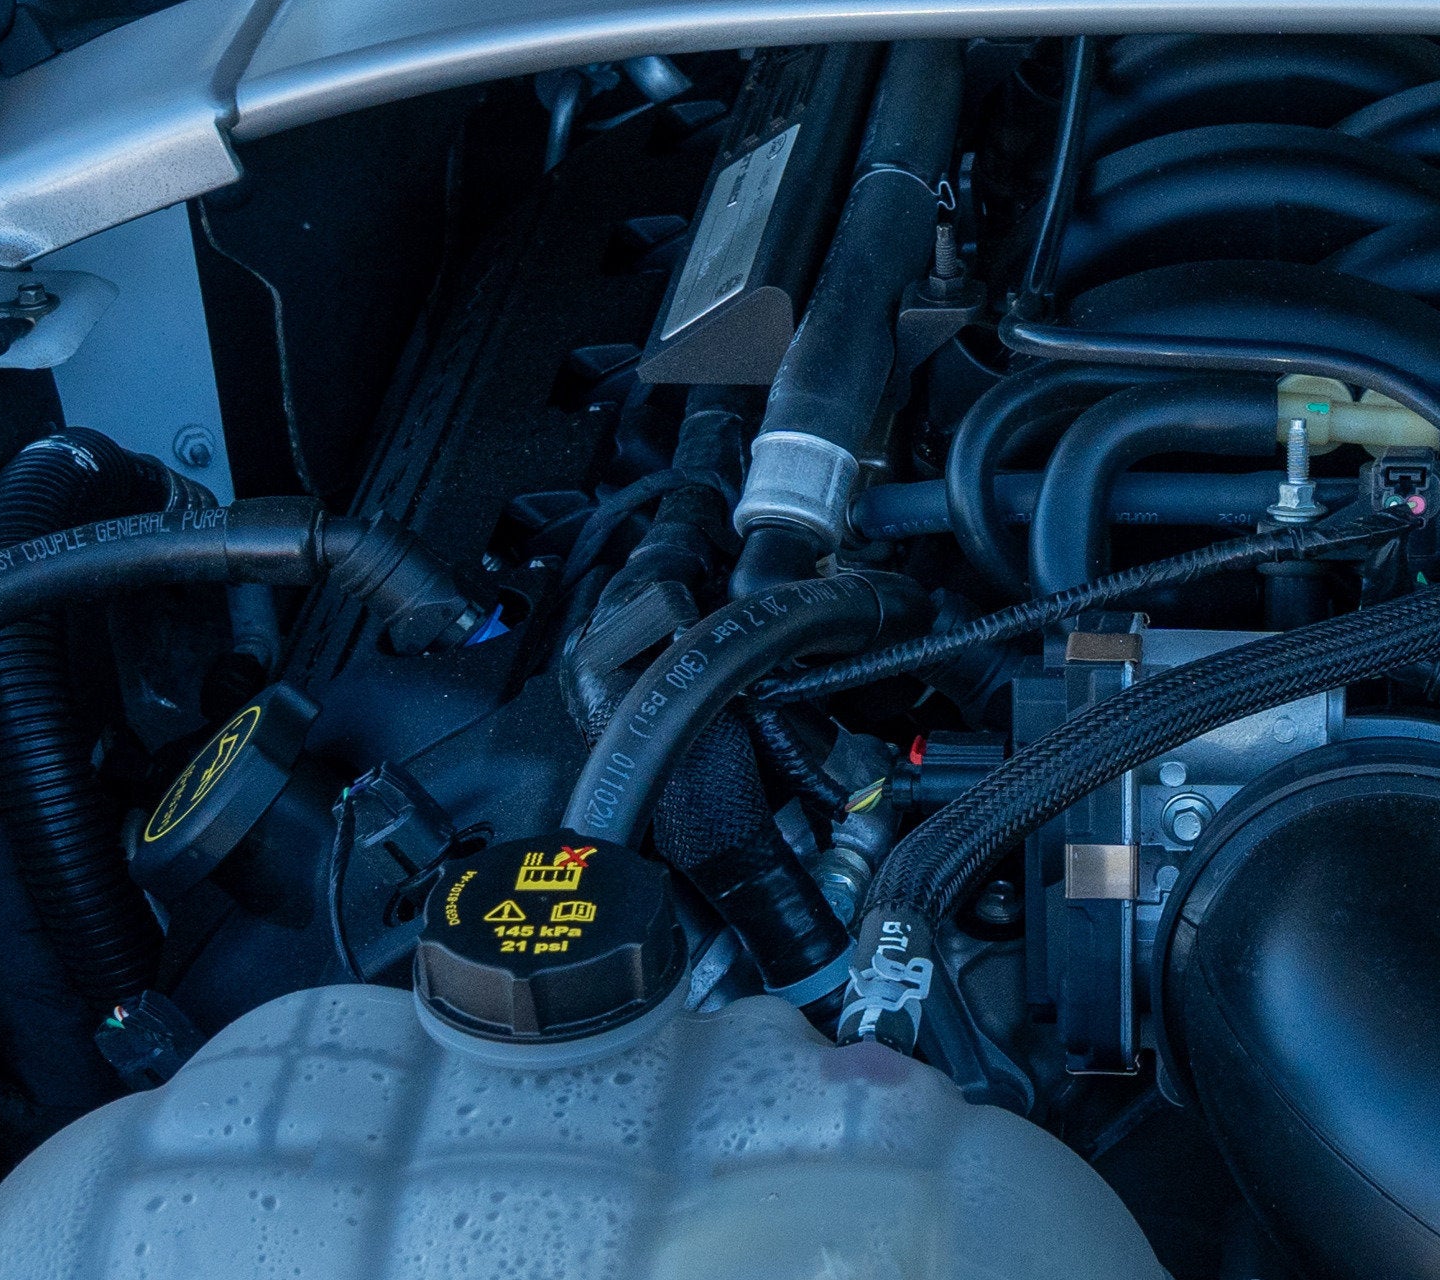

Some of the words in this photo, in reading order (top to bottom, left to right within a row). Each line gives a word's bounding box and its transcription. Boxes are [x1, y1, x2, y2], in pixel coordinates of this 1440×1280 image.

[22, 524, 87, 563] COUPLE
[94, 513, 170, 544] GENERAL
[711, 621, 748, 644] bar
[666, 648, 710, 689] (300
[629, 692, 668, 740] psi)
[494, 925, 534, 938] 145
[539, 925, 582, 938] kPa
[500, 940, 527, 952] 21
[534, 940, 569, 955] psi
